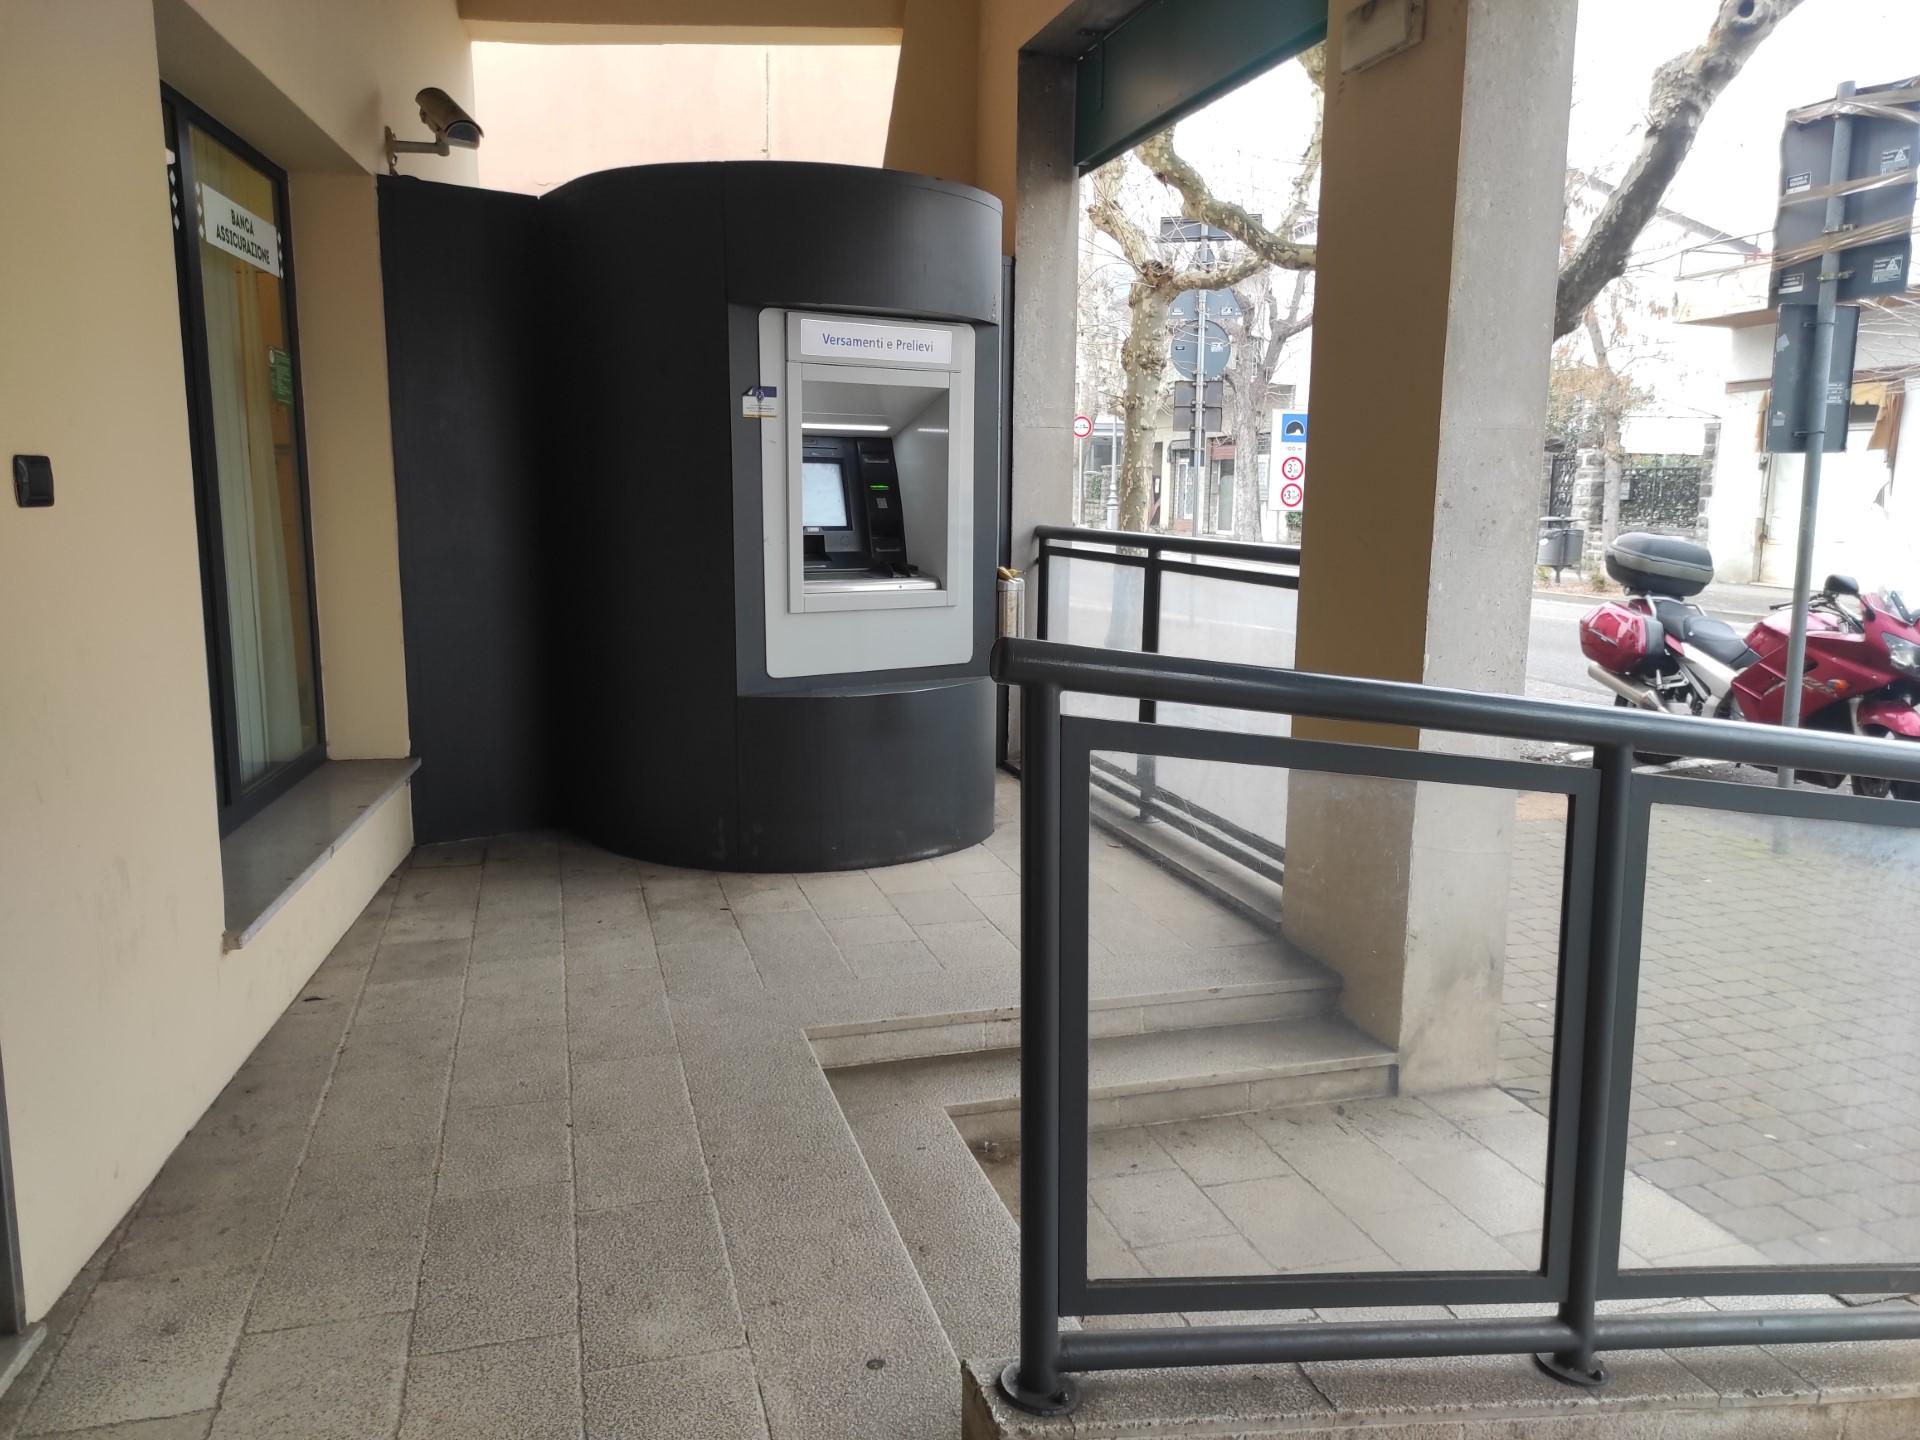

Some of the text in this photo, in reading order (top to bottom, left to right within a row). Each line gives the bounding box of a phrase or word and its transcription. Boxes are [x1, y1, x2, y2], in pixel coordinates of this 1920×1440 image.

[230, 208, 255, 237] BANCA
[216, 223, 270, 265] ASSICURAZIONE
[822, 332, 934, 353] Versamenti e Prelievi
